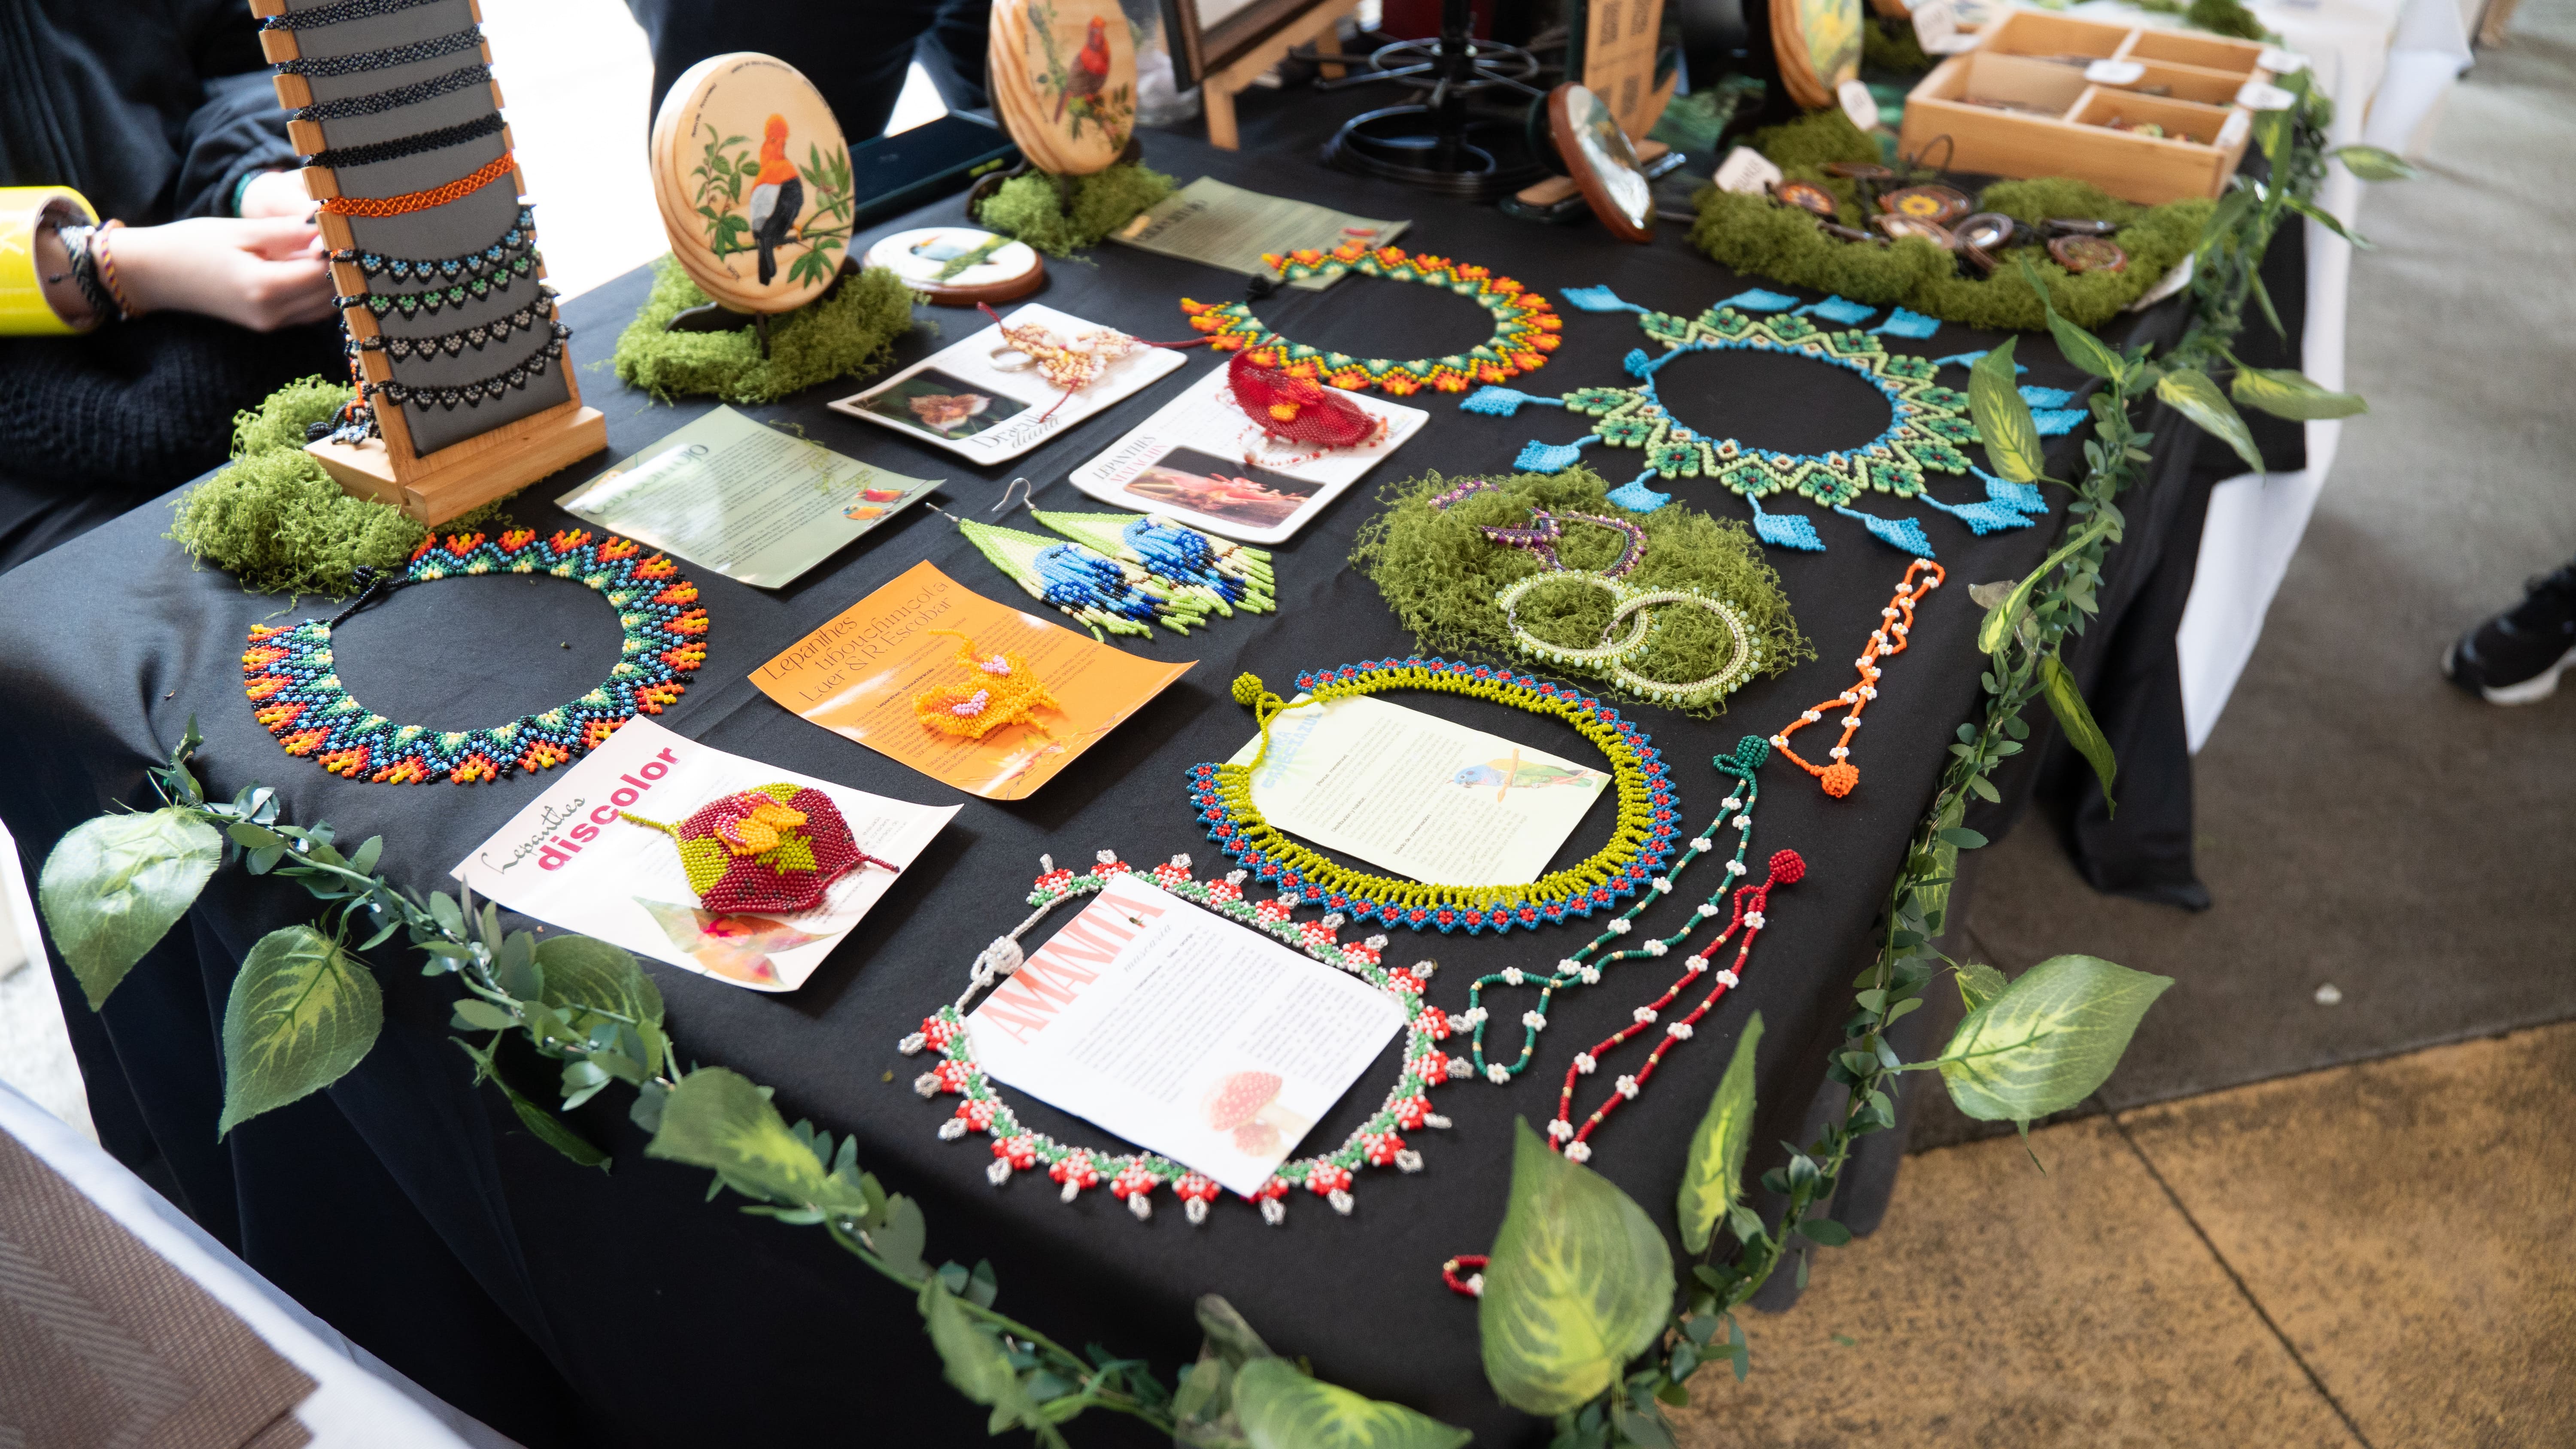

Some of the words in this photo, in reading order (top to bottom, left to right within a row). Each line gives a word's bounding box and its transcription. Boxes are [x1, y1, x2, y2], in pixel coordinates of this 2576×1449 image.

[970, 412, 1056, 448] Dracula
[1012, 416, 1060, 449] diana
[1093, 436, 1156, 480] LEPANTHES
[762, 616, 858, 680] Lepanthes
[799, 669, 847, 702] Luer
[845, 655, 868, 676] &
[860, 644, 888, 659] R.
[880, 597, 952, 646] Escobar
[814, 582, 948, 670] tibouchinicola
[875, 691, 902, 708] Lepanthes
[902, 668, 935, 690] tibouchinicola
[480, 793, 586, 875] Lepanthes
[537, 746, 685, 873] discolor
[1331, 812, 1352, 832] Distribución
[1393, 843, 1406, 855] Estado
[1410, 814, 1431, 837] conservación:
[980, 891, 1166, 1045] AMANITA
[1121, 921, 1173, 973] muscaria
